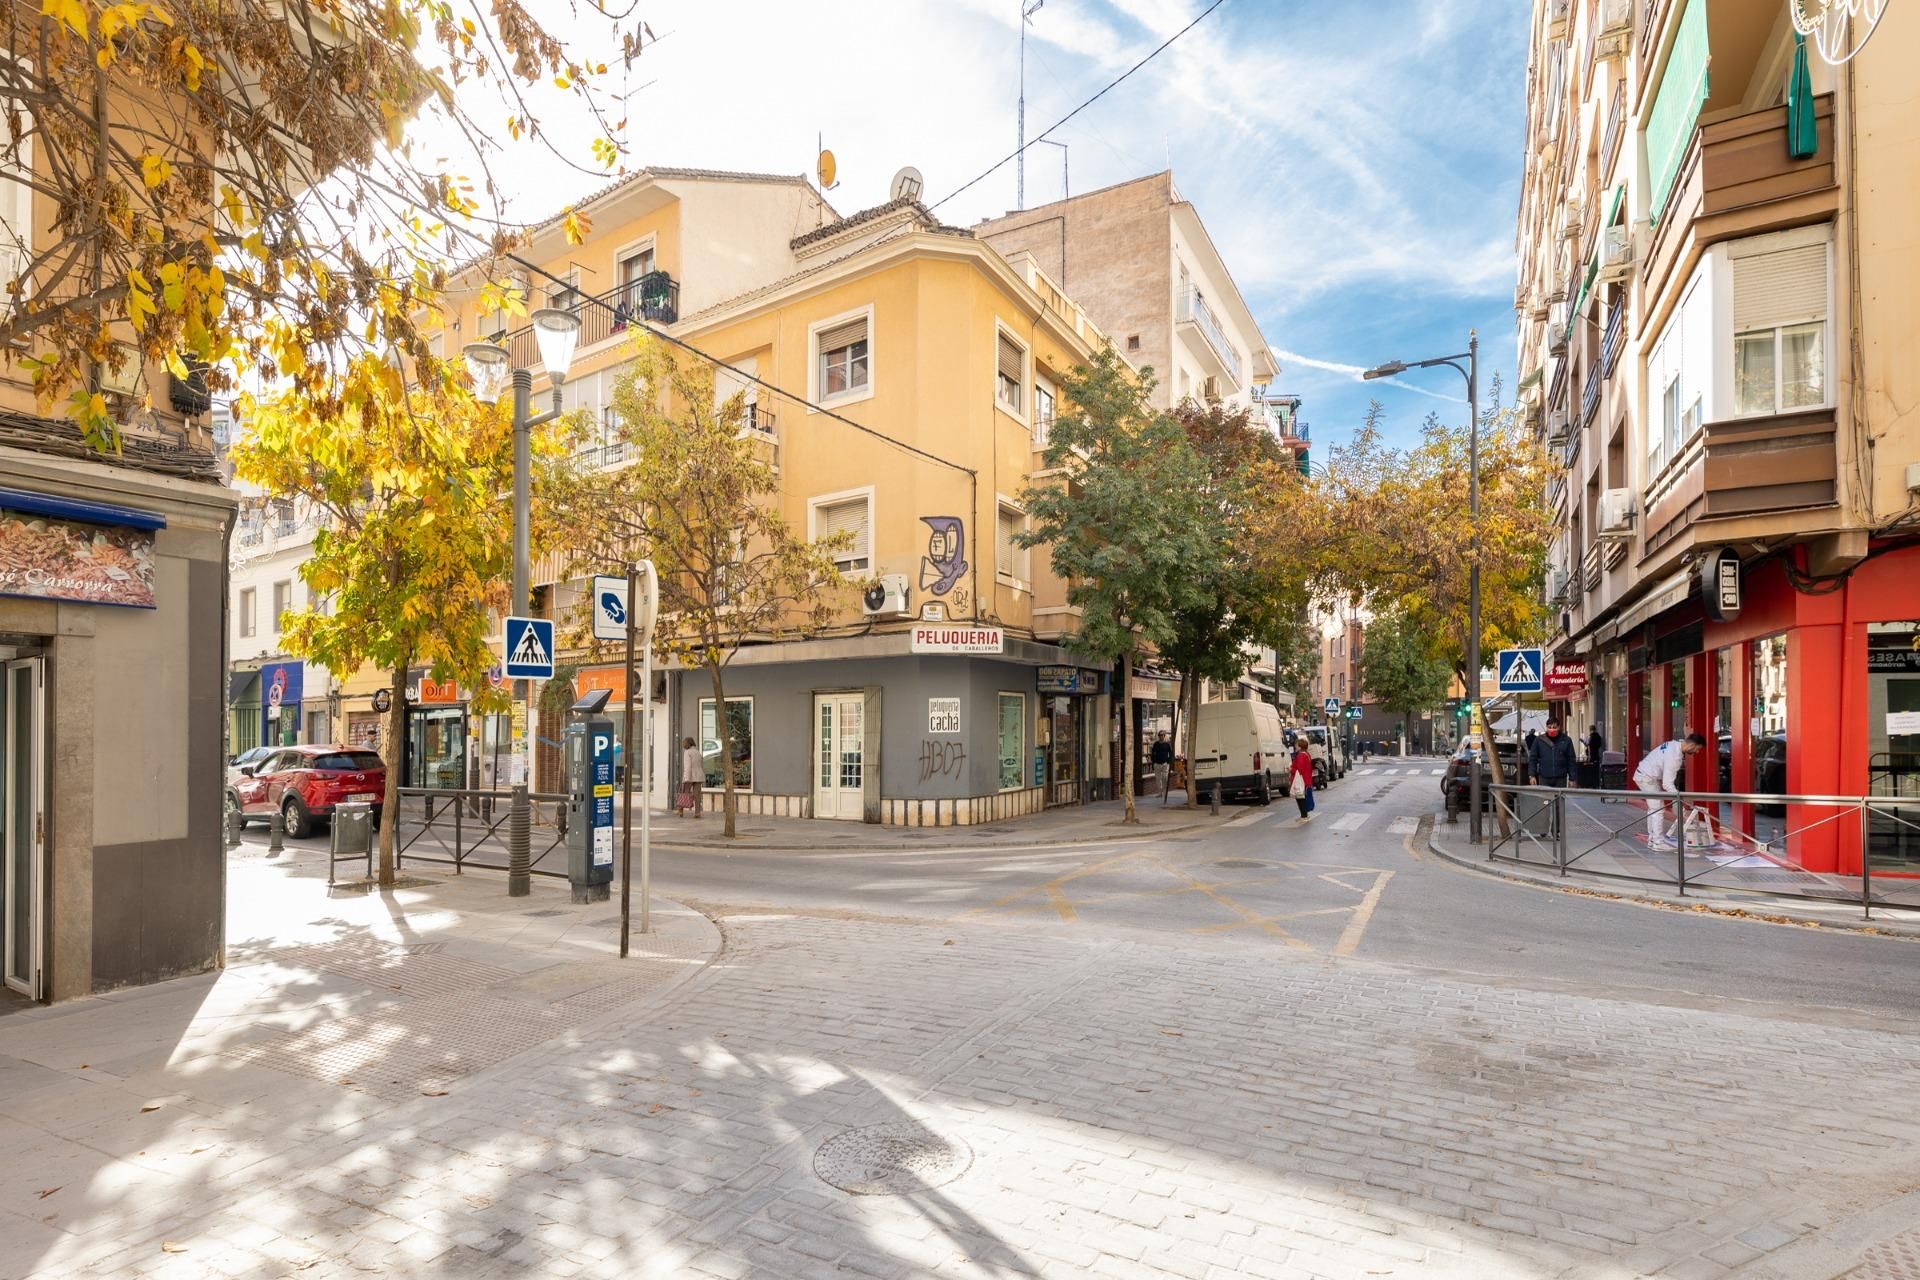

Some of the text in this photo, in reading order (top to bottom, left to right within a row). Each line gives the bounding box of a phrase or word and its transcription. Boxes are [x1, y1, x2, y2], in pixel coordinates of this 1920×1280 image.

[917, 630, 999, 645] PELUQUERIA
[930, 712, 959, 731] cachá
[595, 736, 609, 757] P
